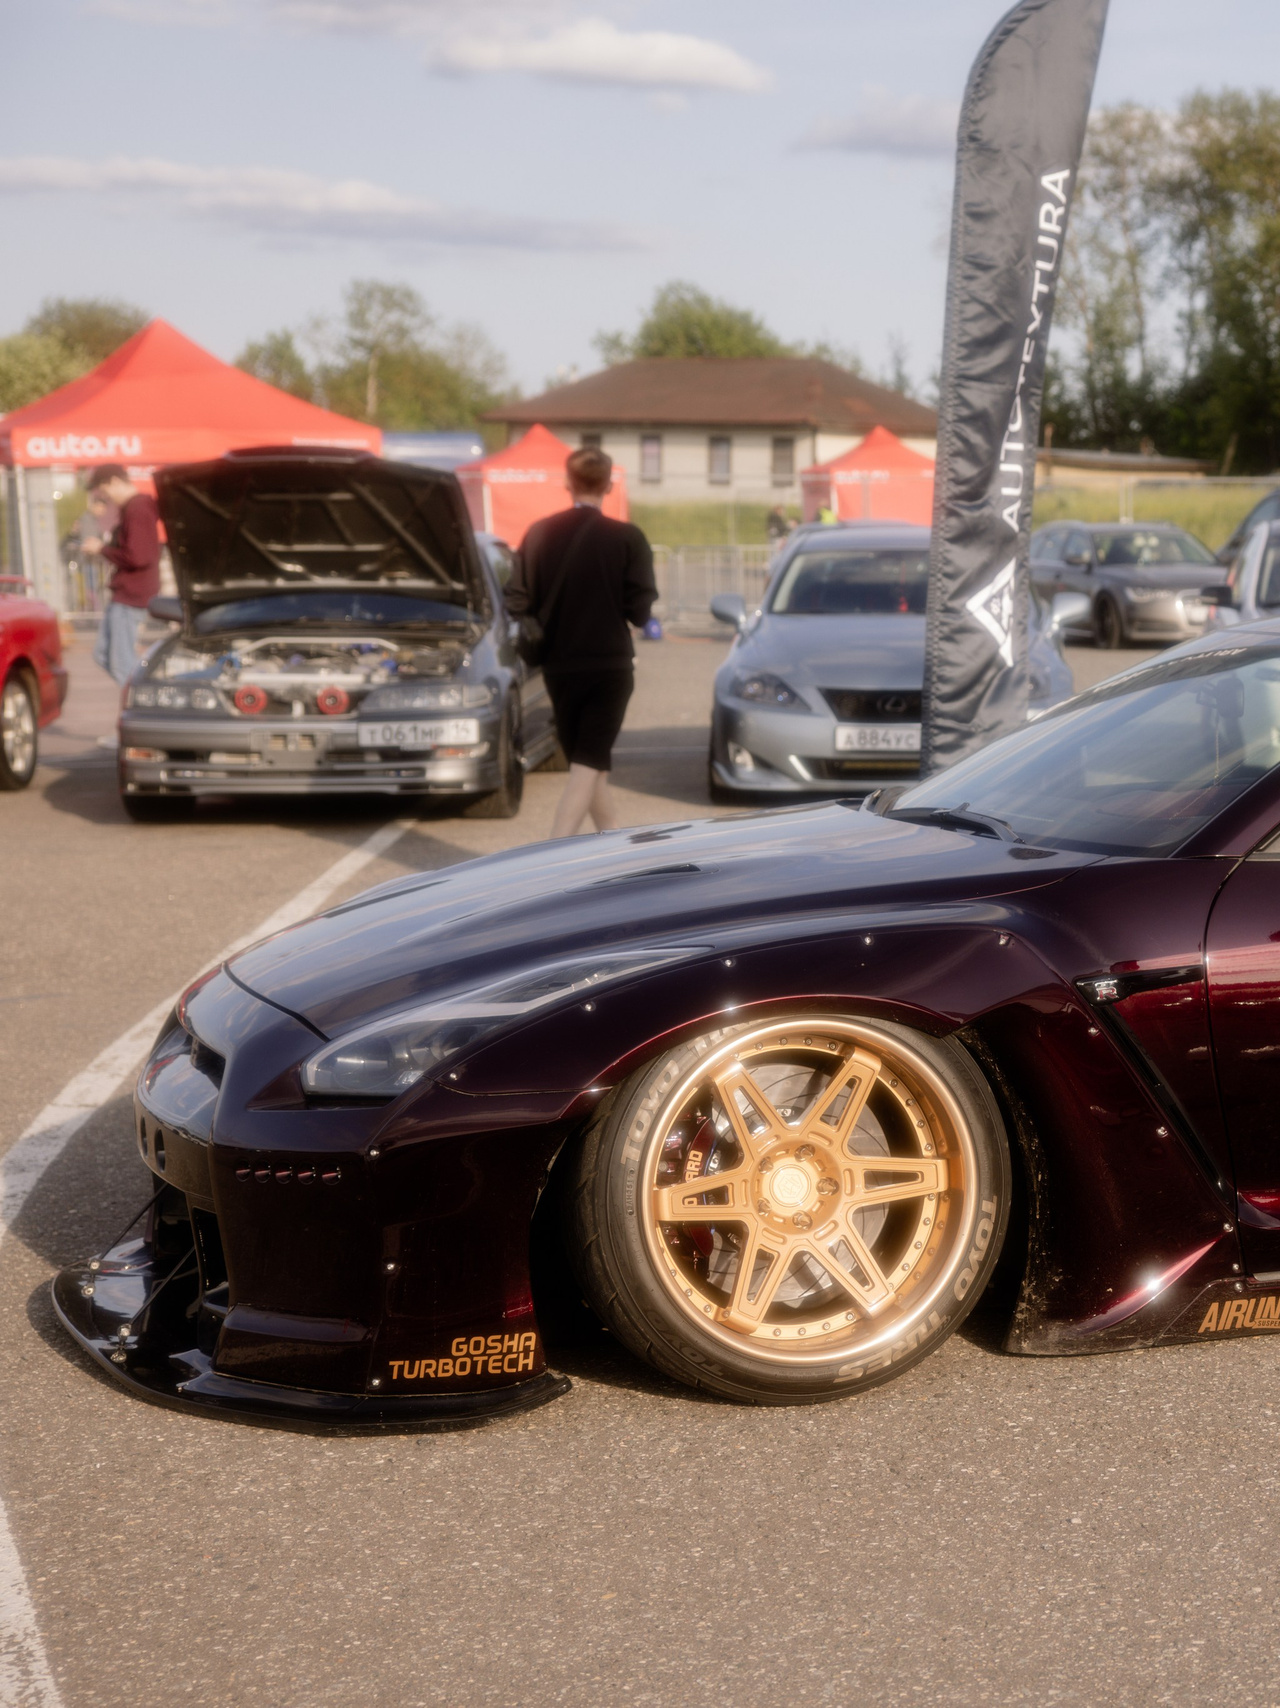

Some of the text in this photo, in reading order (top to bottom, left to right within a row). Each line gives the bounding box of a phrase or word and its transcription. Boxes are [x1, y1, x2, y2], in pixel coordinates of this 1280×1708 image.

[27, 433, 142, 459] auto.ru
[620, 1059, 680, 1166] TOYO
[953, 1194, 999, 1302] TOYO
[389, 1351, 535, 1380] TURBOTECH
[451, 1331, 537, 1357] GOSHA
[833, 1310, 950, 1384] TIRES
